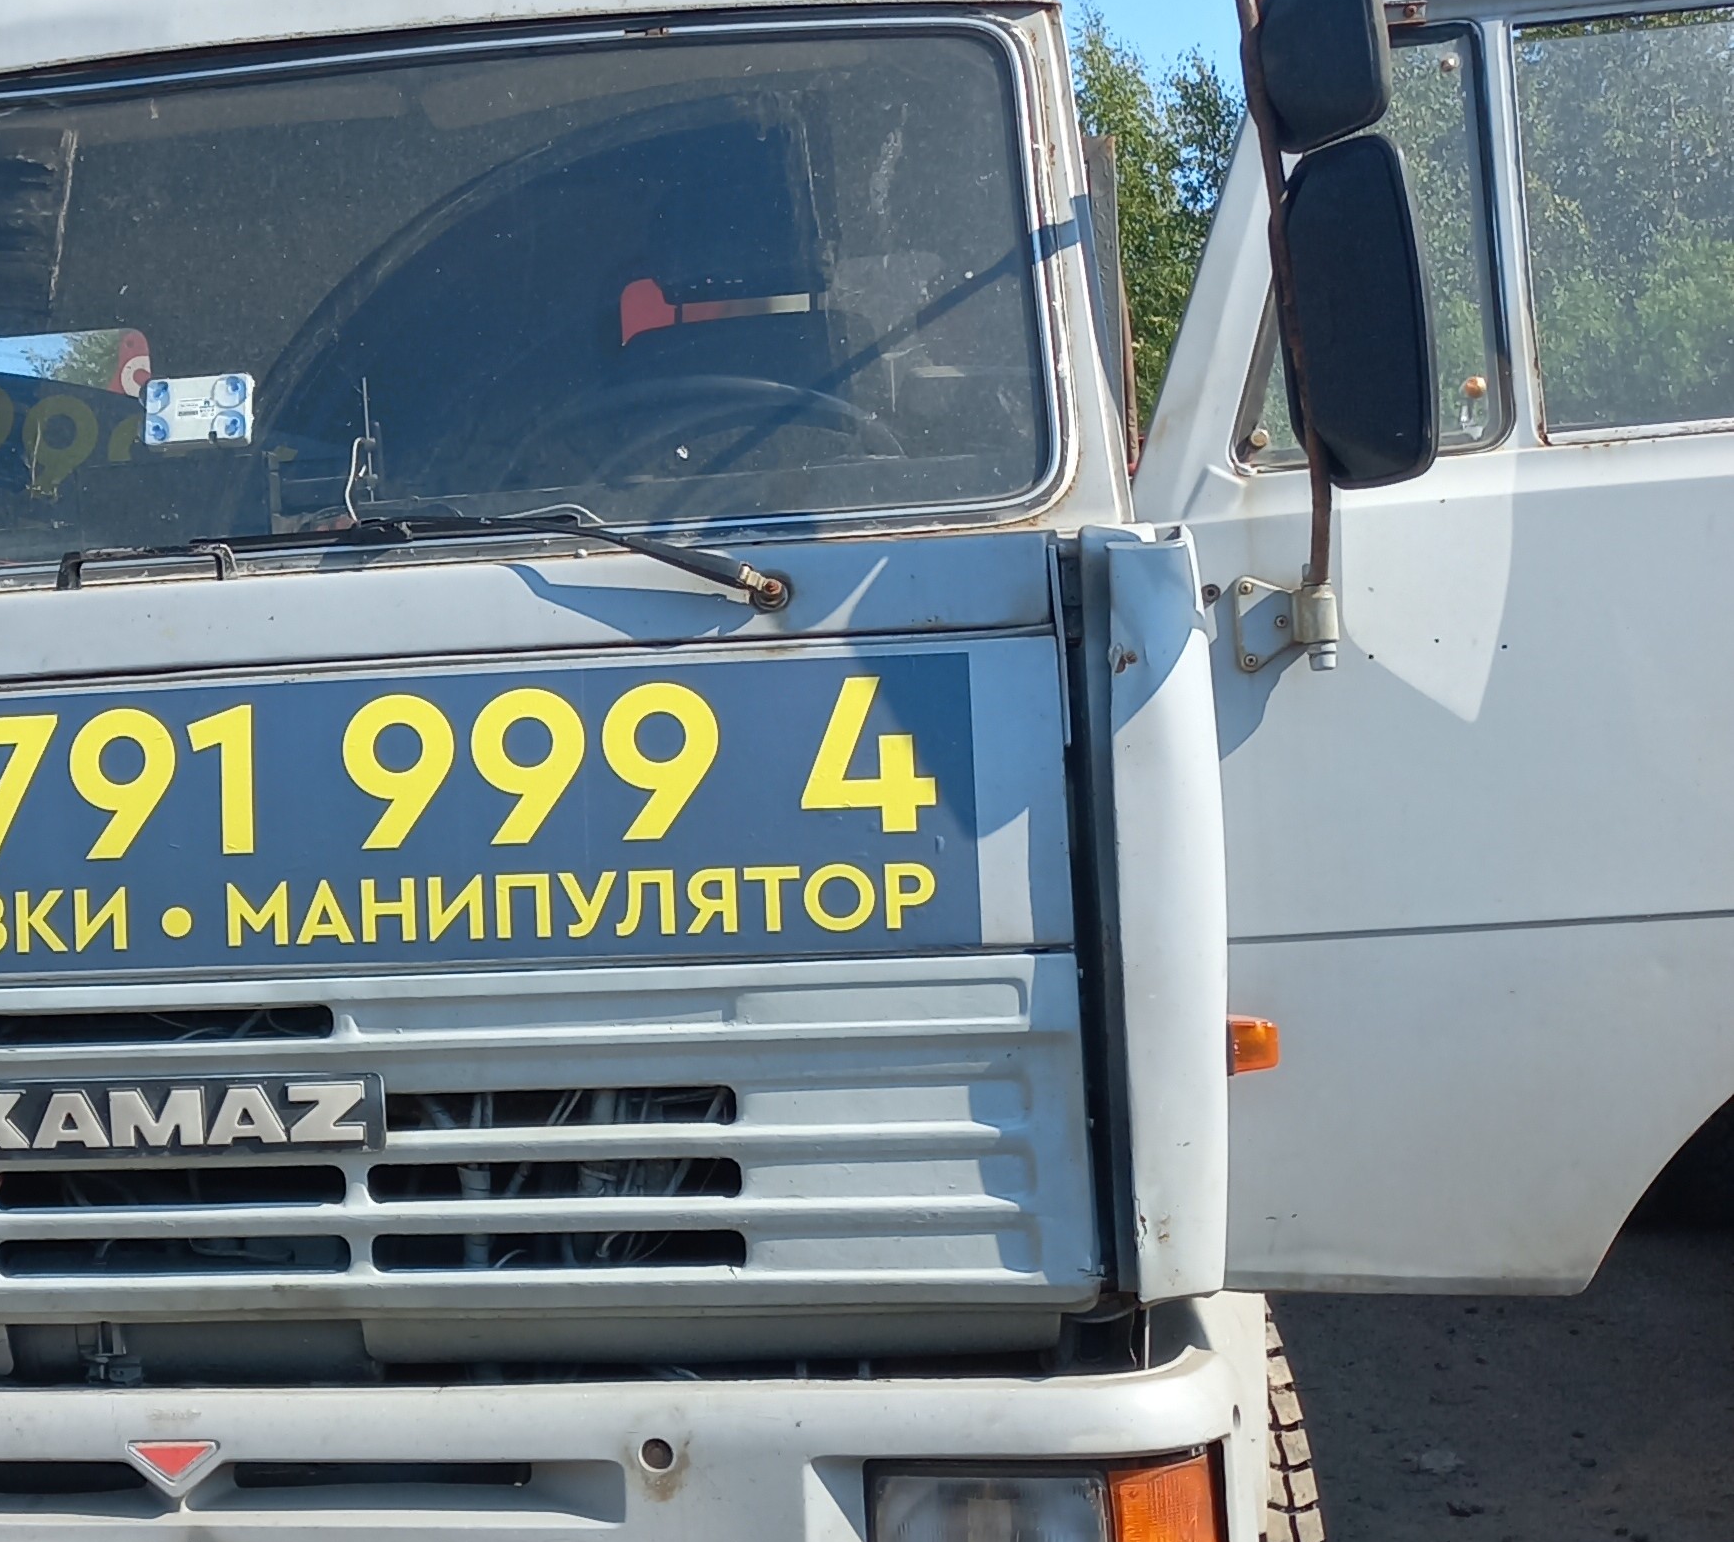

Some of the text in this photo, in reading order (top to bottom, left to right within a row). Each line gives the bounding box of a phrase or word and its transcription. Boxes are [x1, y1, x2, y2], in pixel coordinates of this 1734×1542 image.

[342, 682, 719, 850] 999
[800, 676, 937, 833] 4
[226, 863, 936, 948] МАНИПУЛЯТОР
